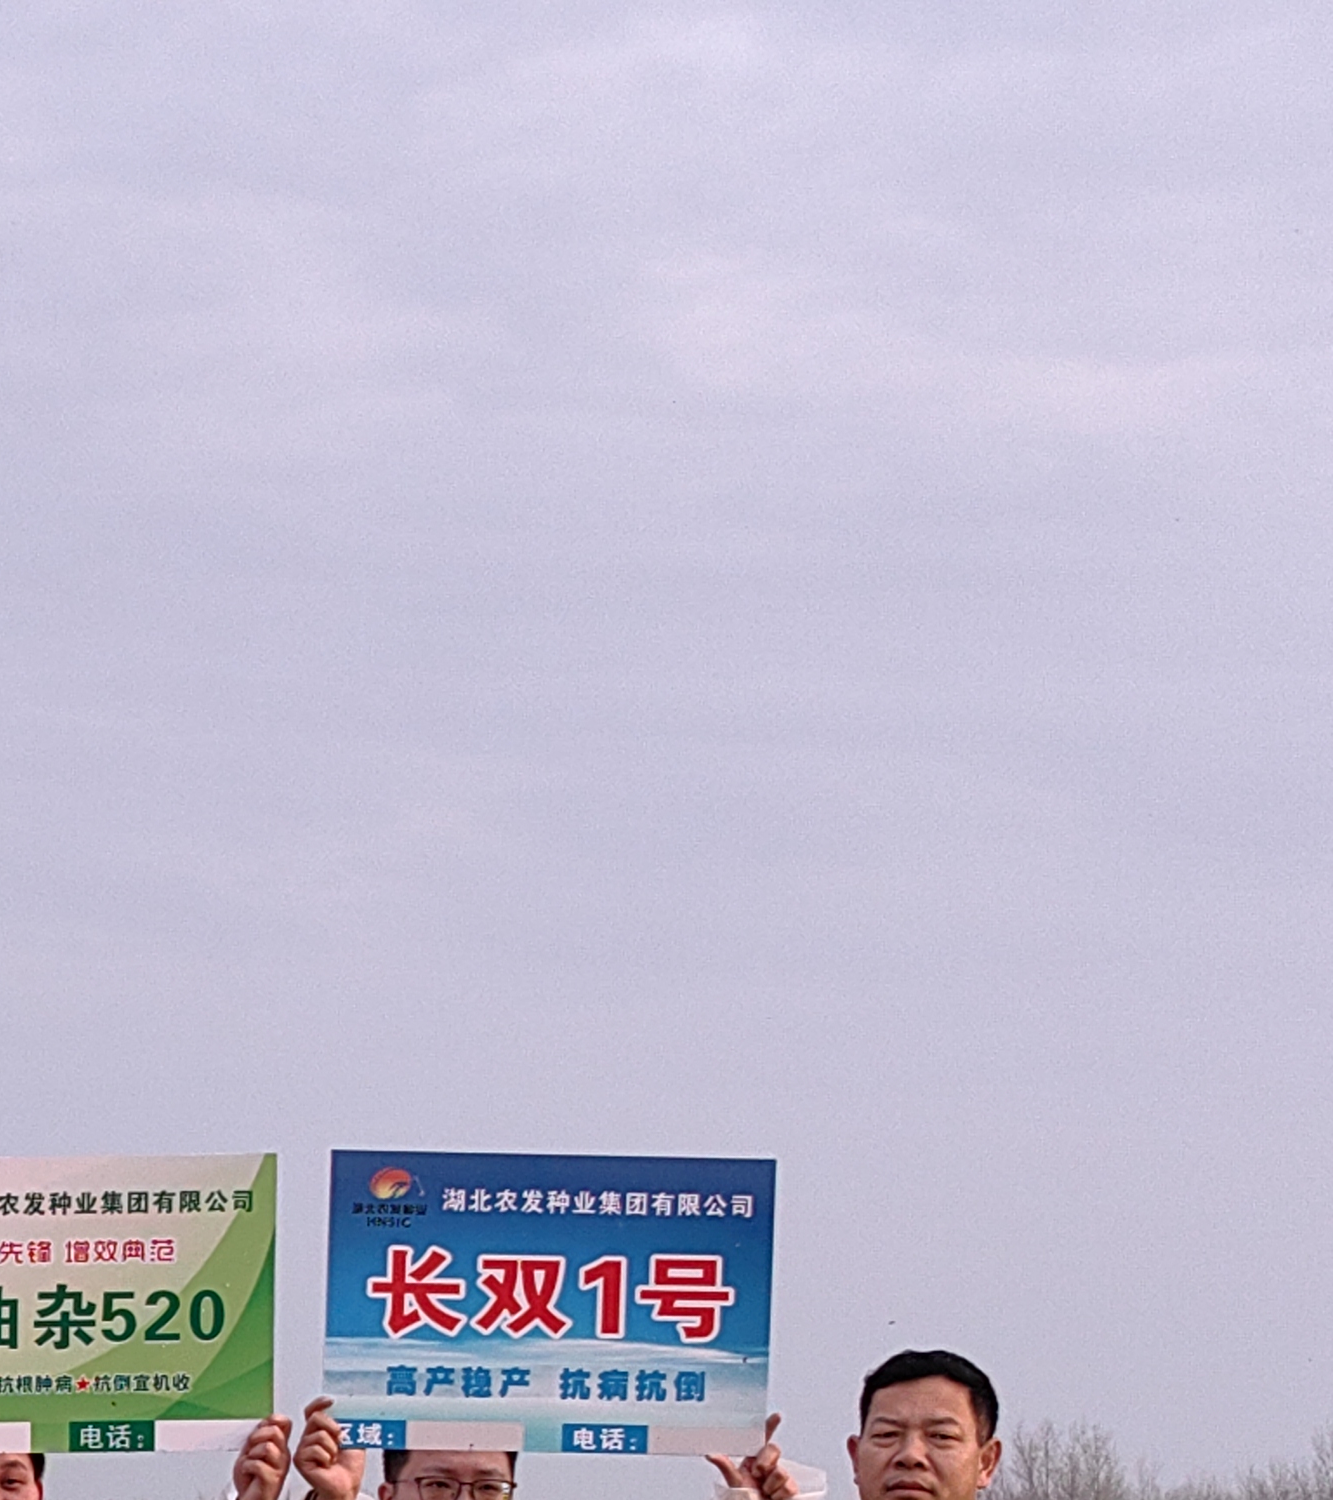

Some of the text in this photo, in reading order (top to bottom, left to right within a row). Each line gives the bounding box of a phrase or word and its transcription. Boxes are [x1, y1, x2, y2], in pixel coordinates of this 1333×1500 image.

[441, 1187, 754, 1218] 湖北农发种业集团有限公司
[64, 1239, 175, 1264] 增效典范
[368, 1245, 733, 1342] 长双1号
[93, 1373, 191, 1393] 抗倒宜机收
[385, 1364, 706, 1402] 高产稳产 抗病抗倒
[79, 1427, 146, 1450] 电话：
[573, 1428, 637, 1451] 电话：
